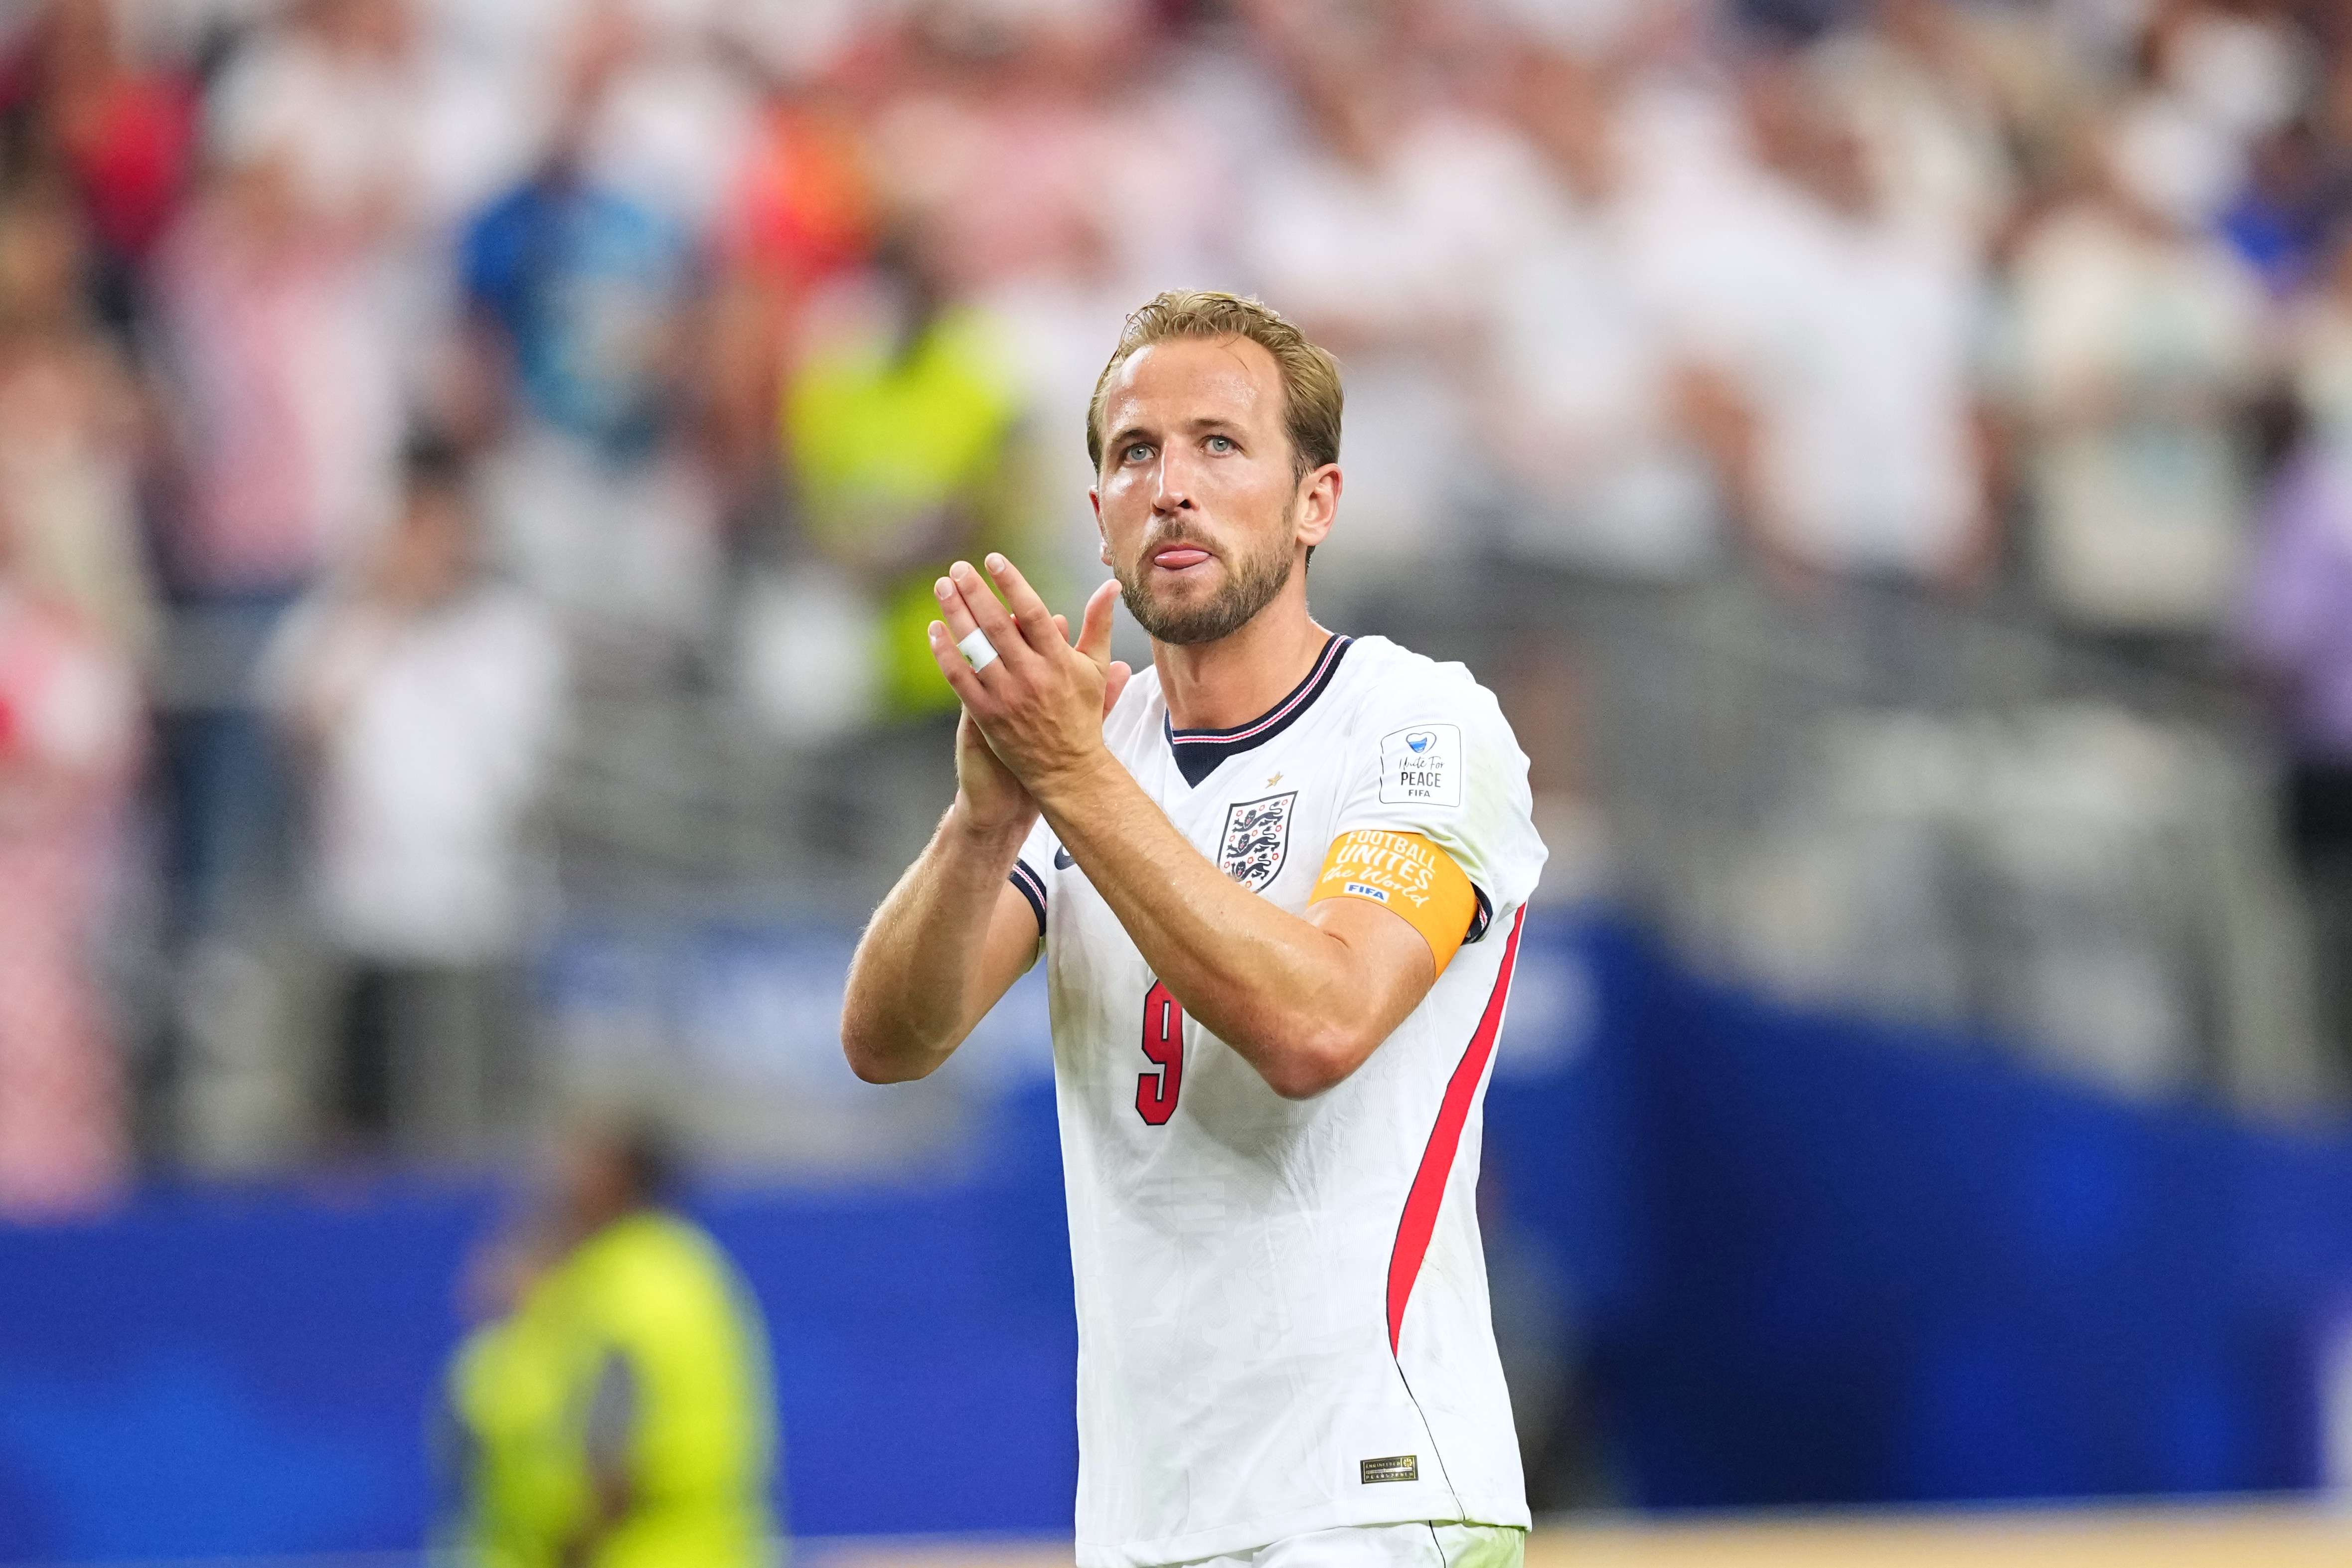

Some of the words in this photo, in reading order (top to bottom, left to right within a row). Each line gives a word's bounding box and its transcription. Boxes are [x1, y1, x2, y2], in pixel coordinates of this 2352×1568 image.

[1401, 772, 1441, 788] PEACE
[1428, 756, 1444, 770] For
[1336, 844, 1433, 890] UNITES
[1346, 830, 1436, 874] FOOTBALL
[1322, 864, 1355, 884] the
[1359, 866, 1430, 908] World
[1349, 885, 1384, 900] FIFA
[1135, 979, 1184, 1125] 9
